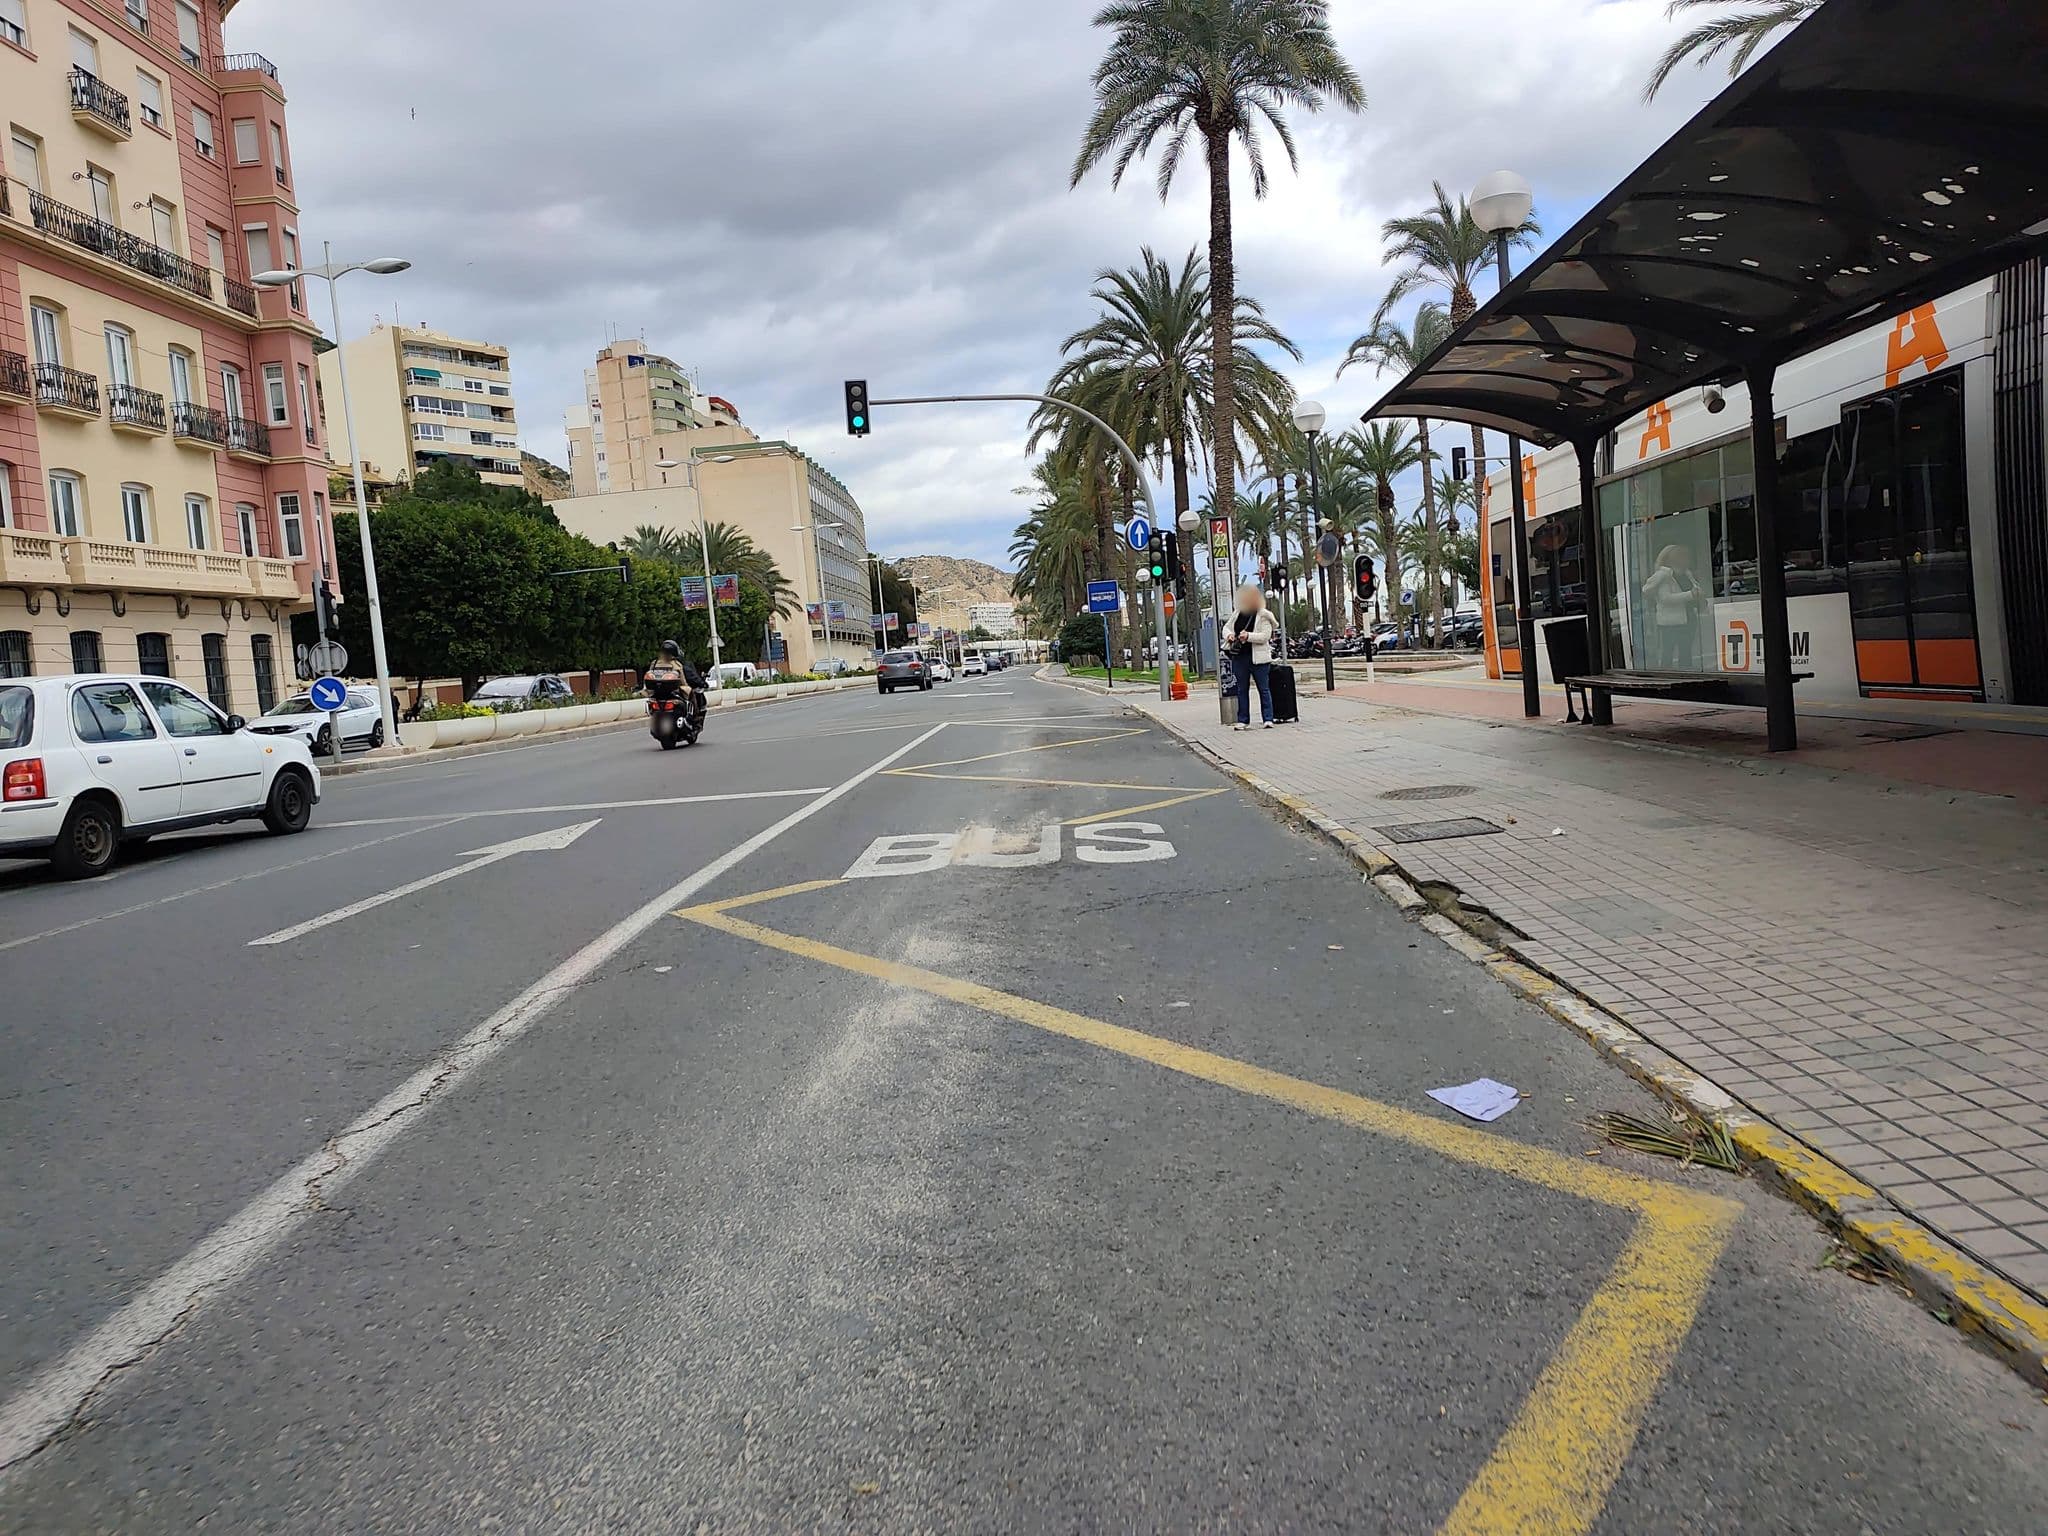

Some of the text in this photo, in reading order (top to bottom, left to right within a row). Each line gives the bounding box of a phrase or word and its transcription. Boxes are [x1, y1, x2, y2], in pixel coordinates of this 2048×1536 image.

[1216, 520, 1223, 534] 2
[1214, 533, 1228, 547] 22
[1752, 631, 1810, 657] TM
[841, 822, 1178, 879] BUS
